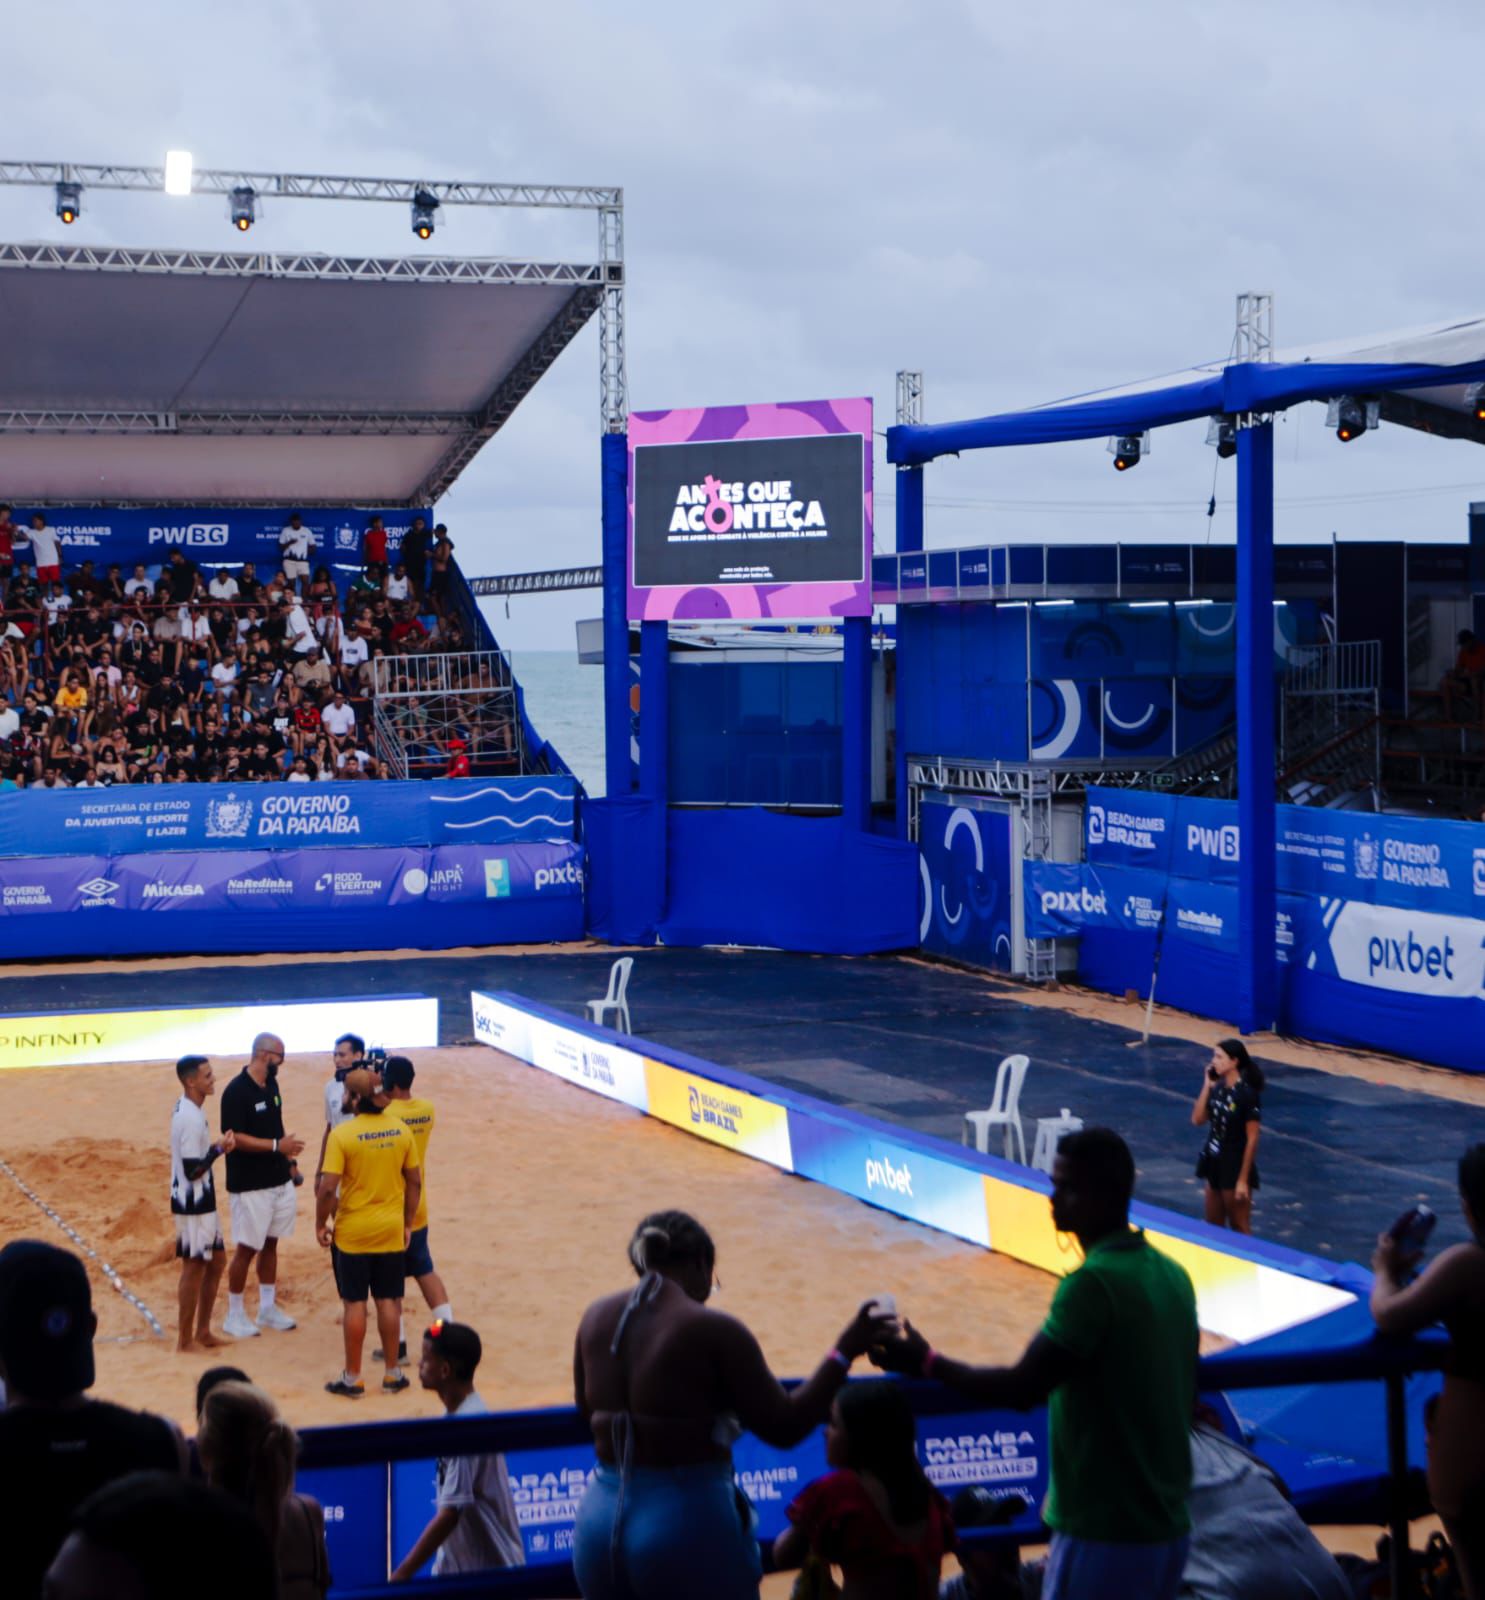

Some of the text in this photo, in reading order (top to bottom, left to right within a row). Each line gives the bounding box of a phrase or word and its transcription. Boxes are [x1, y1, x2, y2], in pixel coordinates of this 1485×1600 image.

[676, 475, 791, 504] ANTES QUE
[669, 501, 826, 533] ACONTEÇA
[60, 535, 100, 546] AZIL
[72, 526, 111, 535] GAMES
[148, 524, 229, 546] PWBG
[81, 800, 191, 814] SECRETARIA DE ESTADO
[262, 794, 351, 815] GOVERNO
[65, 813, 189, 828] DA JUVENTUDE, ESPORTE
[258, 811, 360, 836] DA PARAÍBA
[1107, 811, 1165, 832] BEACH GAMES
[146, 826, 187, 838] E LAZER
[1107, 826, 1156, 849] BRAZIL
[1383, 838, 1441, 865] GOVERNO
[334, 880, 382, 890] EVERTON
[1382, 861, 1450, 889] DA PARAÍBA
[3, 886, 45, 896] GOVERNO
[430, 884, 463, 892] NIGHT
[3, 895, 16, 906] DA
[81, 896, 116, 907] umbro
[1041, 886, 1108, 915] pixbet
[1369, 930, 1454, 981] pixbet
[15, 1031, 107, 1049] INFINITY
[701, 1092, 743, 1119] BEACH GAMES
[702, 1108, 738, 1134] BRAZIL
[357, 1129, 401, 1142] TÉCNICA
[925, 1430, 1035, 1451] PARAÍBA
[926, 1445, 1019, 1465] WORLD
[741, 1466, 798, 1483] GAMES
[928, 1460, 1034, 1480] BEACH GAMES
[513, 1483, 587, 1503] ORLD
